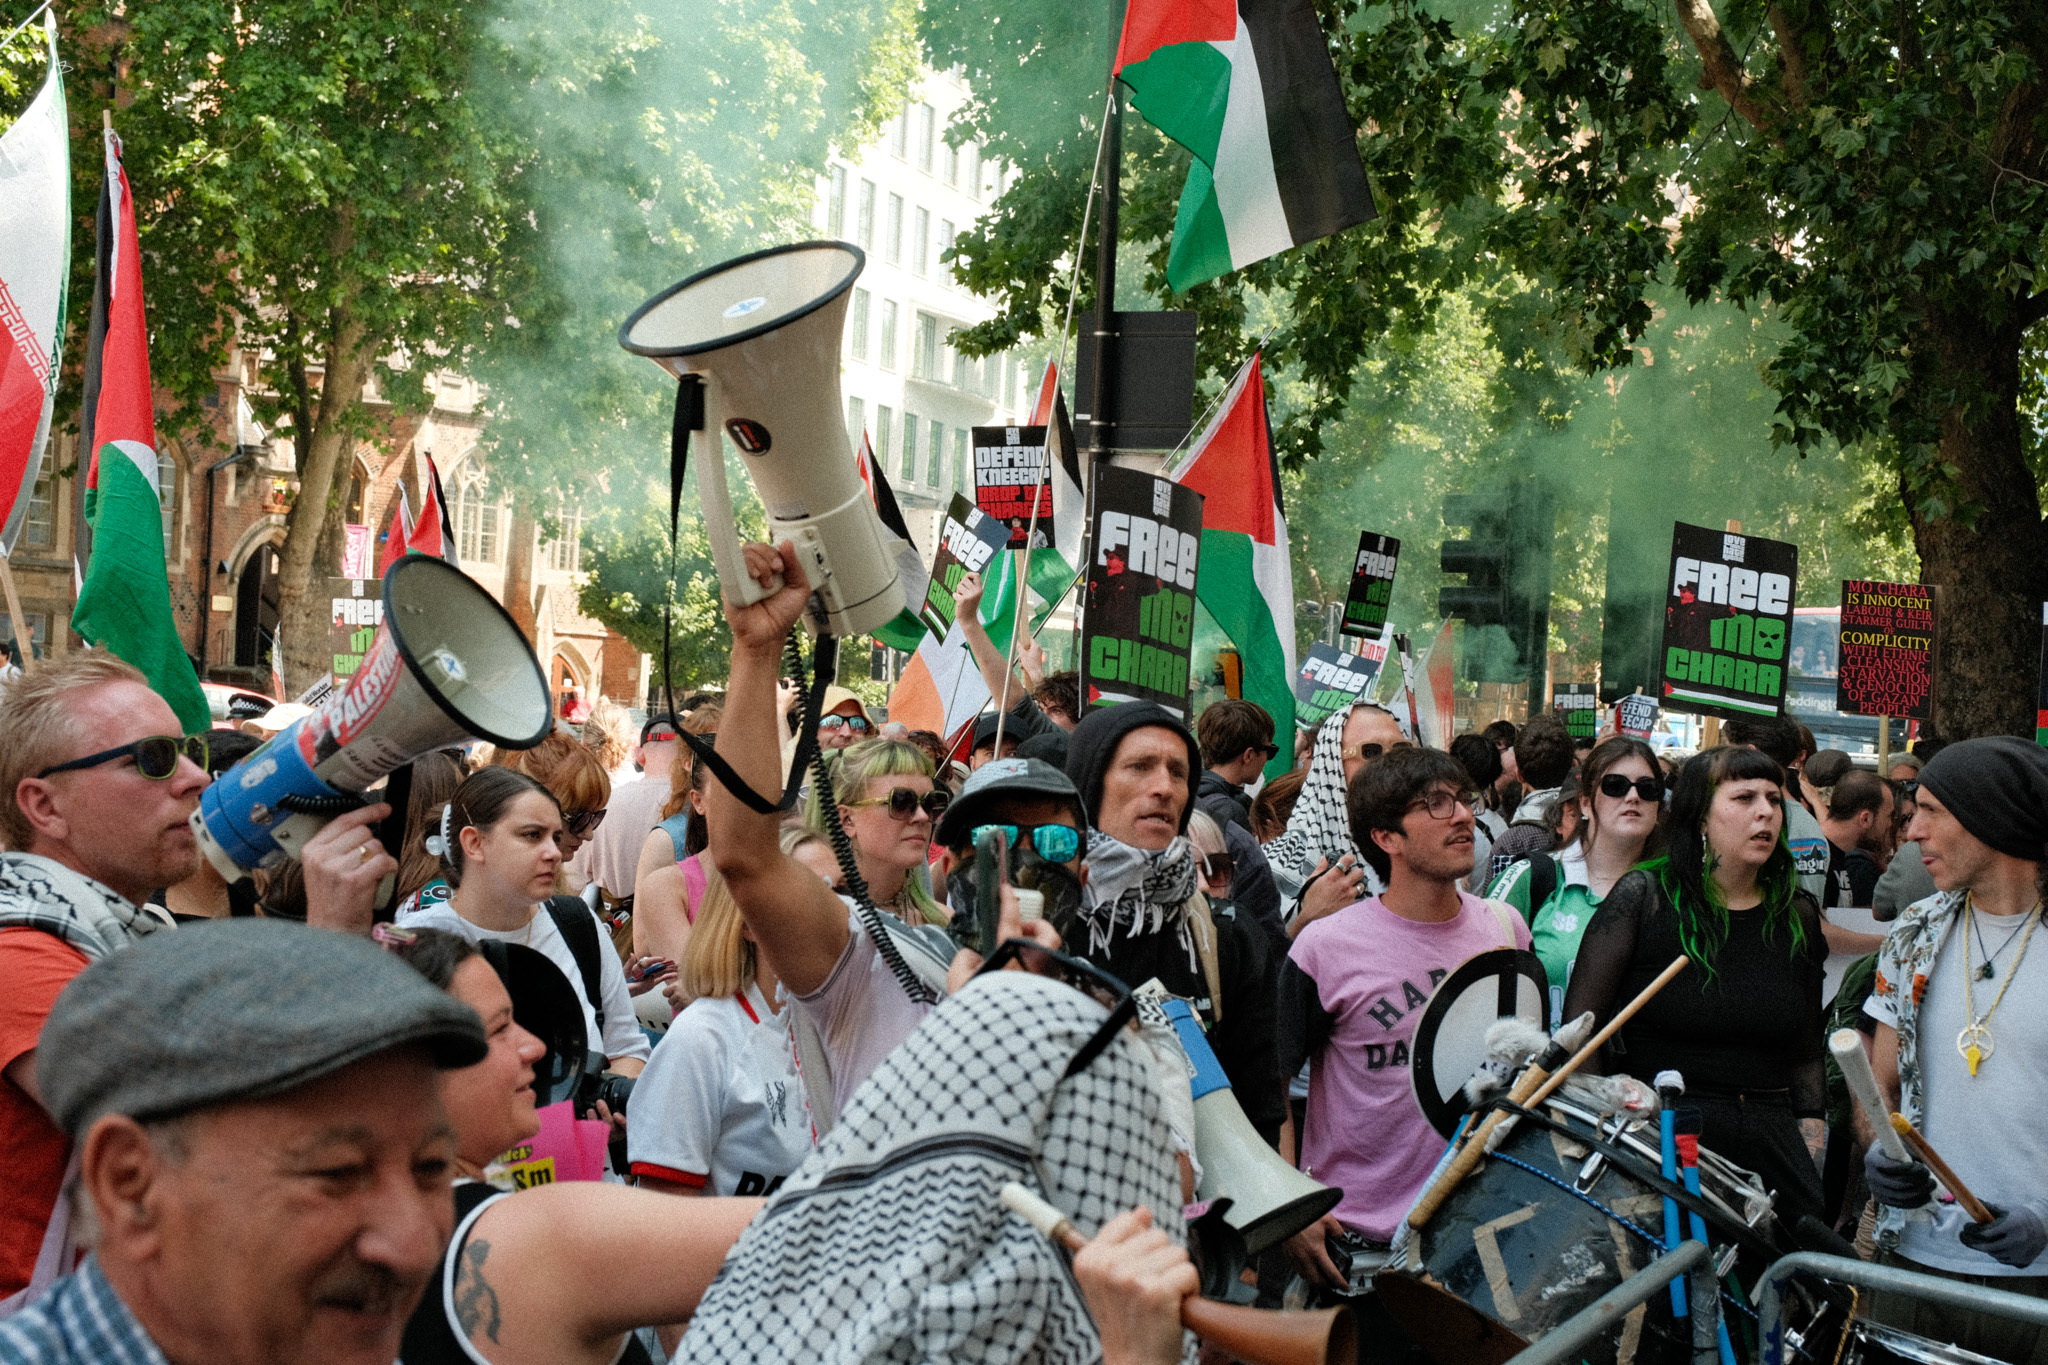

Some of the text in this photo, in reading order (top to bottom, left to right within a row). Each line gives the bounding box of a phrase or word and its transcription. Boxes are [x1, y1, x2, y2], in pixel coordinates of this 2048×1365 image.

[975, 446, 1049, 468] DEFEND
[976, 467, 1050, 486] KNEECAP
[977, 486, 1020, 502] DROP
[1848, 581, 1928, 598] MO CHARA
[1848, 593, 1932, 610] IS INNOCENT
[1846, 605, 1932, 620] LABOUR & KEIR
[1842, 615, 1934, 631] STARMER GUILTY
[1841, 631, 1931, 650] COMPLICITY
[1843, 645, 1931, 662] WITH ETHNIC
[1089, 635, 1188, 699] CHARA
[1665, 646, 1781, 697] CHARA
[1847, 656, 1925, 673] CLEANSING
[1841, 666, 1931, 685] STARVATION
[1842, 678, 1928, 696] & GENOCIDE
[1848, 689, 1919, 707] OF GAZAN
[1621, 702, 1652, 717] EFEND
[1860, 702, 1910, 717] PEOPLE
[1621, 714, 1652, 730] EECAP
